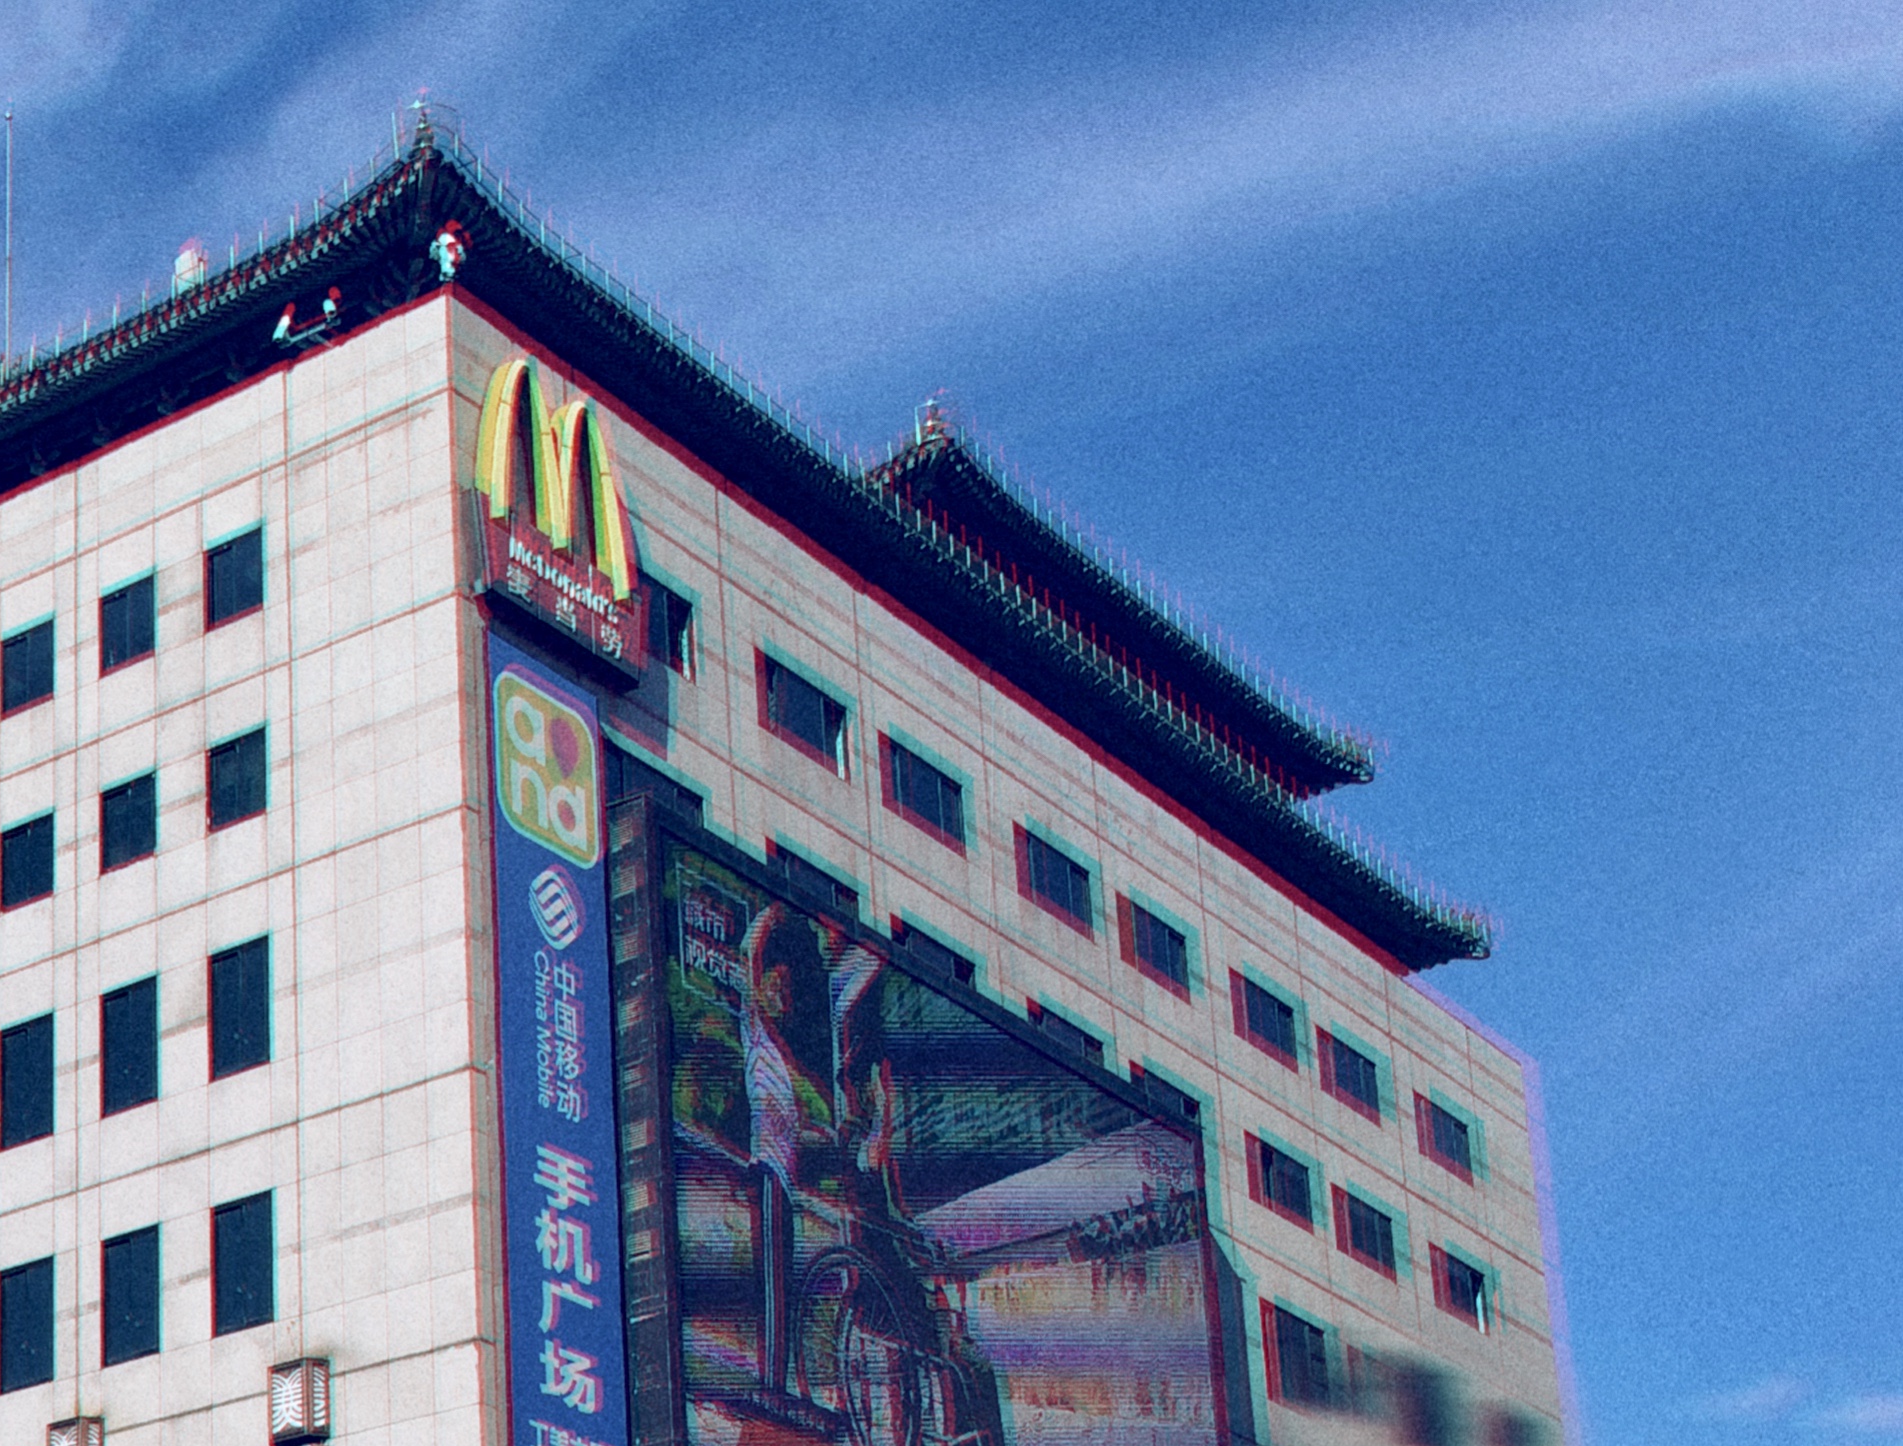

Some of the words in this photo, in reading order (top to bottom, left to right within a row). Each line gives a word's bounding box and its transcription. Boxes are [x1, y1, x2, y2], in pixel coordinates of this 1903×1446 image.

[533, 949, 551, 1016] China
[552, 961, 582, 1124] 中国移动
[536, 1020, 552, 1109] Mobile
[533, 1144, 595, 1415] 手机广场
